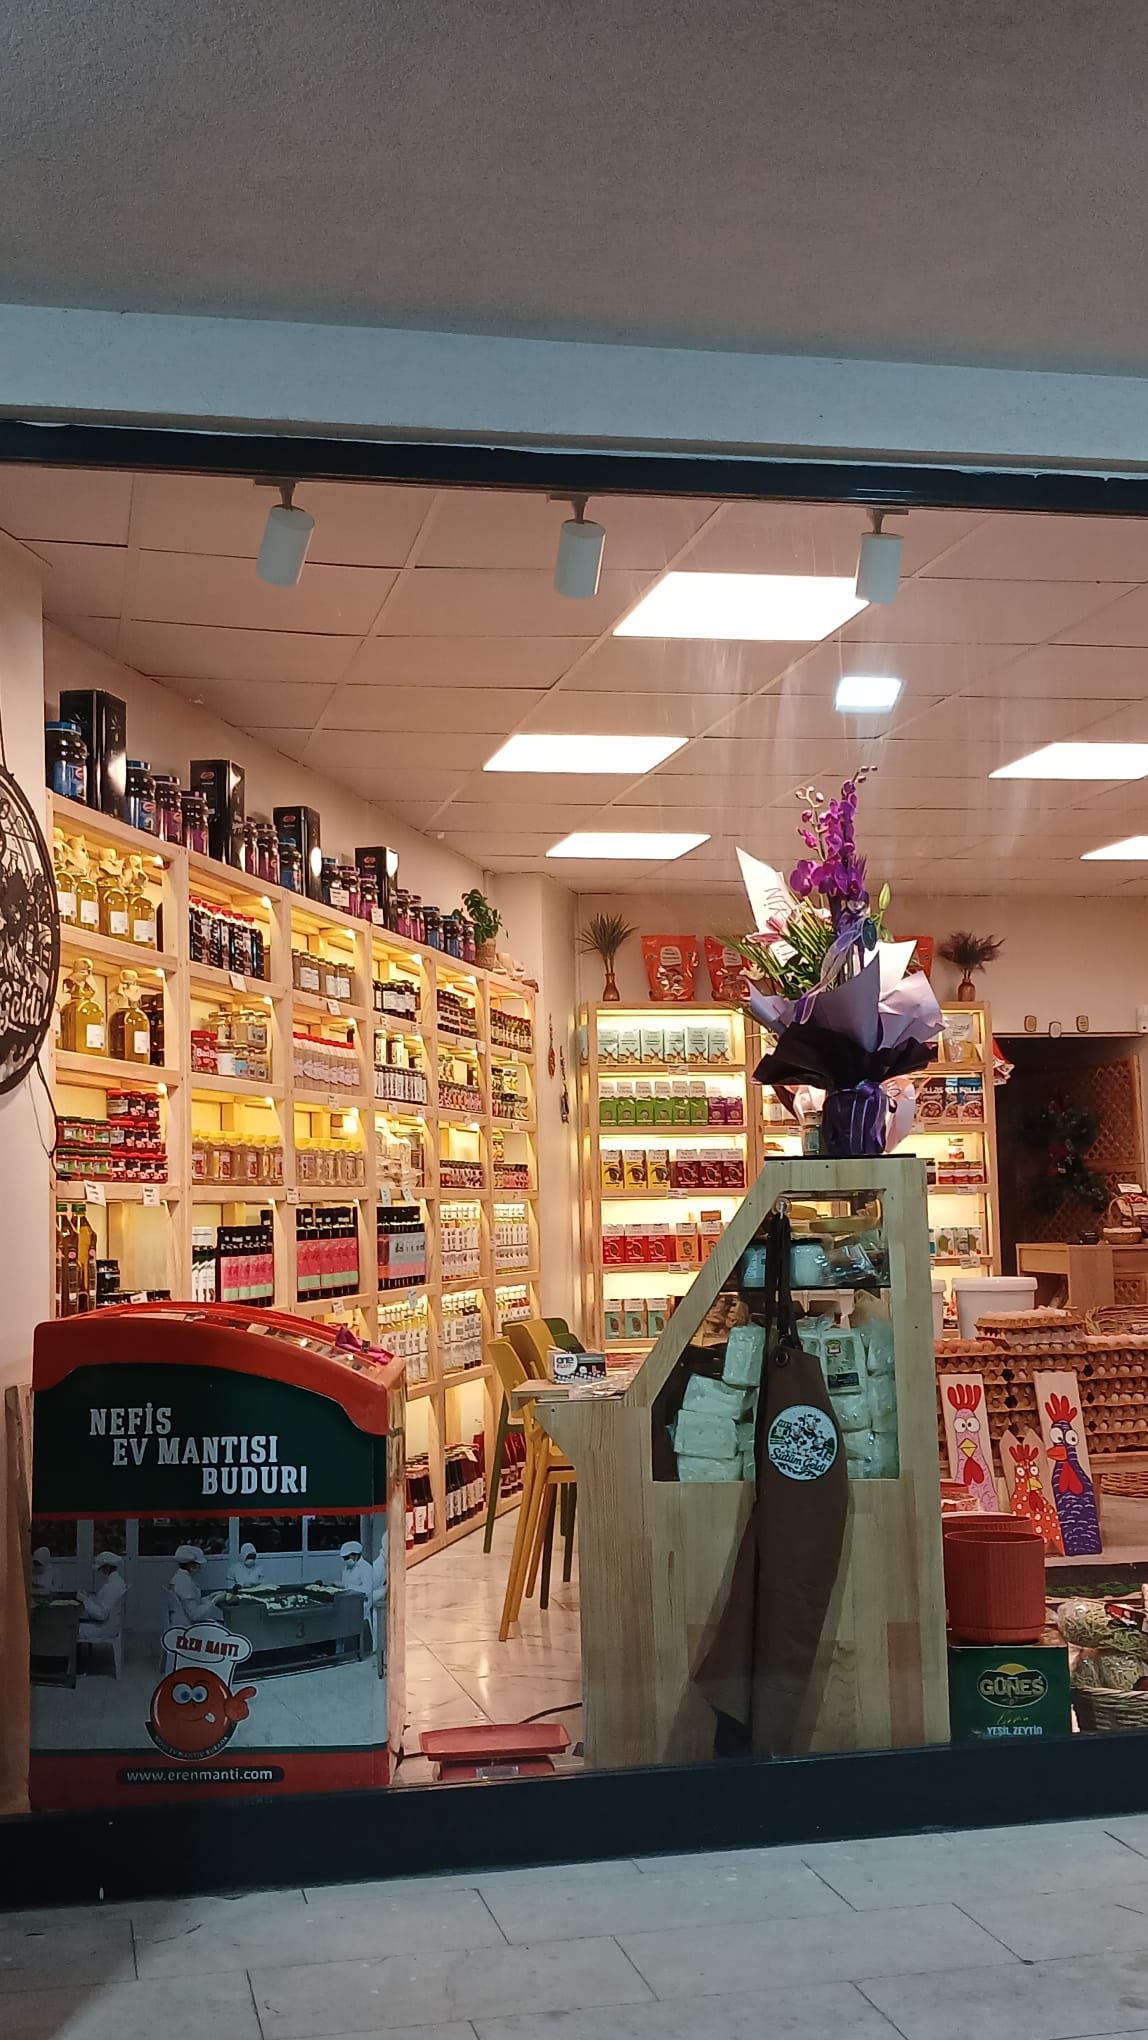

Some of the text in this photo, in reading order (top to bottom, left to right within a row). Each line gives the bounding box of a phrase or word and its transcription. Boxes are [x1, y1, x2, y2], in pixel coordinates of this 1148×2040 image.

[89, 1402, 172, 1435] NEFİS
[112, 1436, 278, 1465] EV MANTISI
[202, 1466, 307, 1494] BUDUR!
[176, 1635, 240, 1657] EREN MANTI
[126, 1767, 273, 1782] www.erenmanti.com
